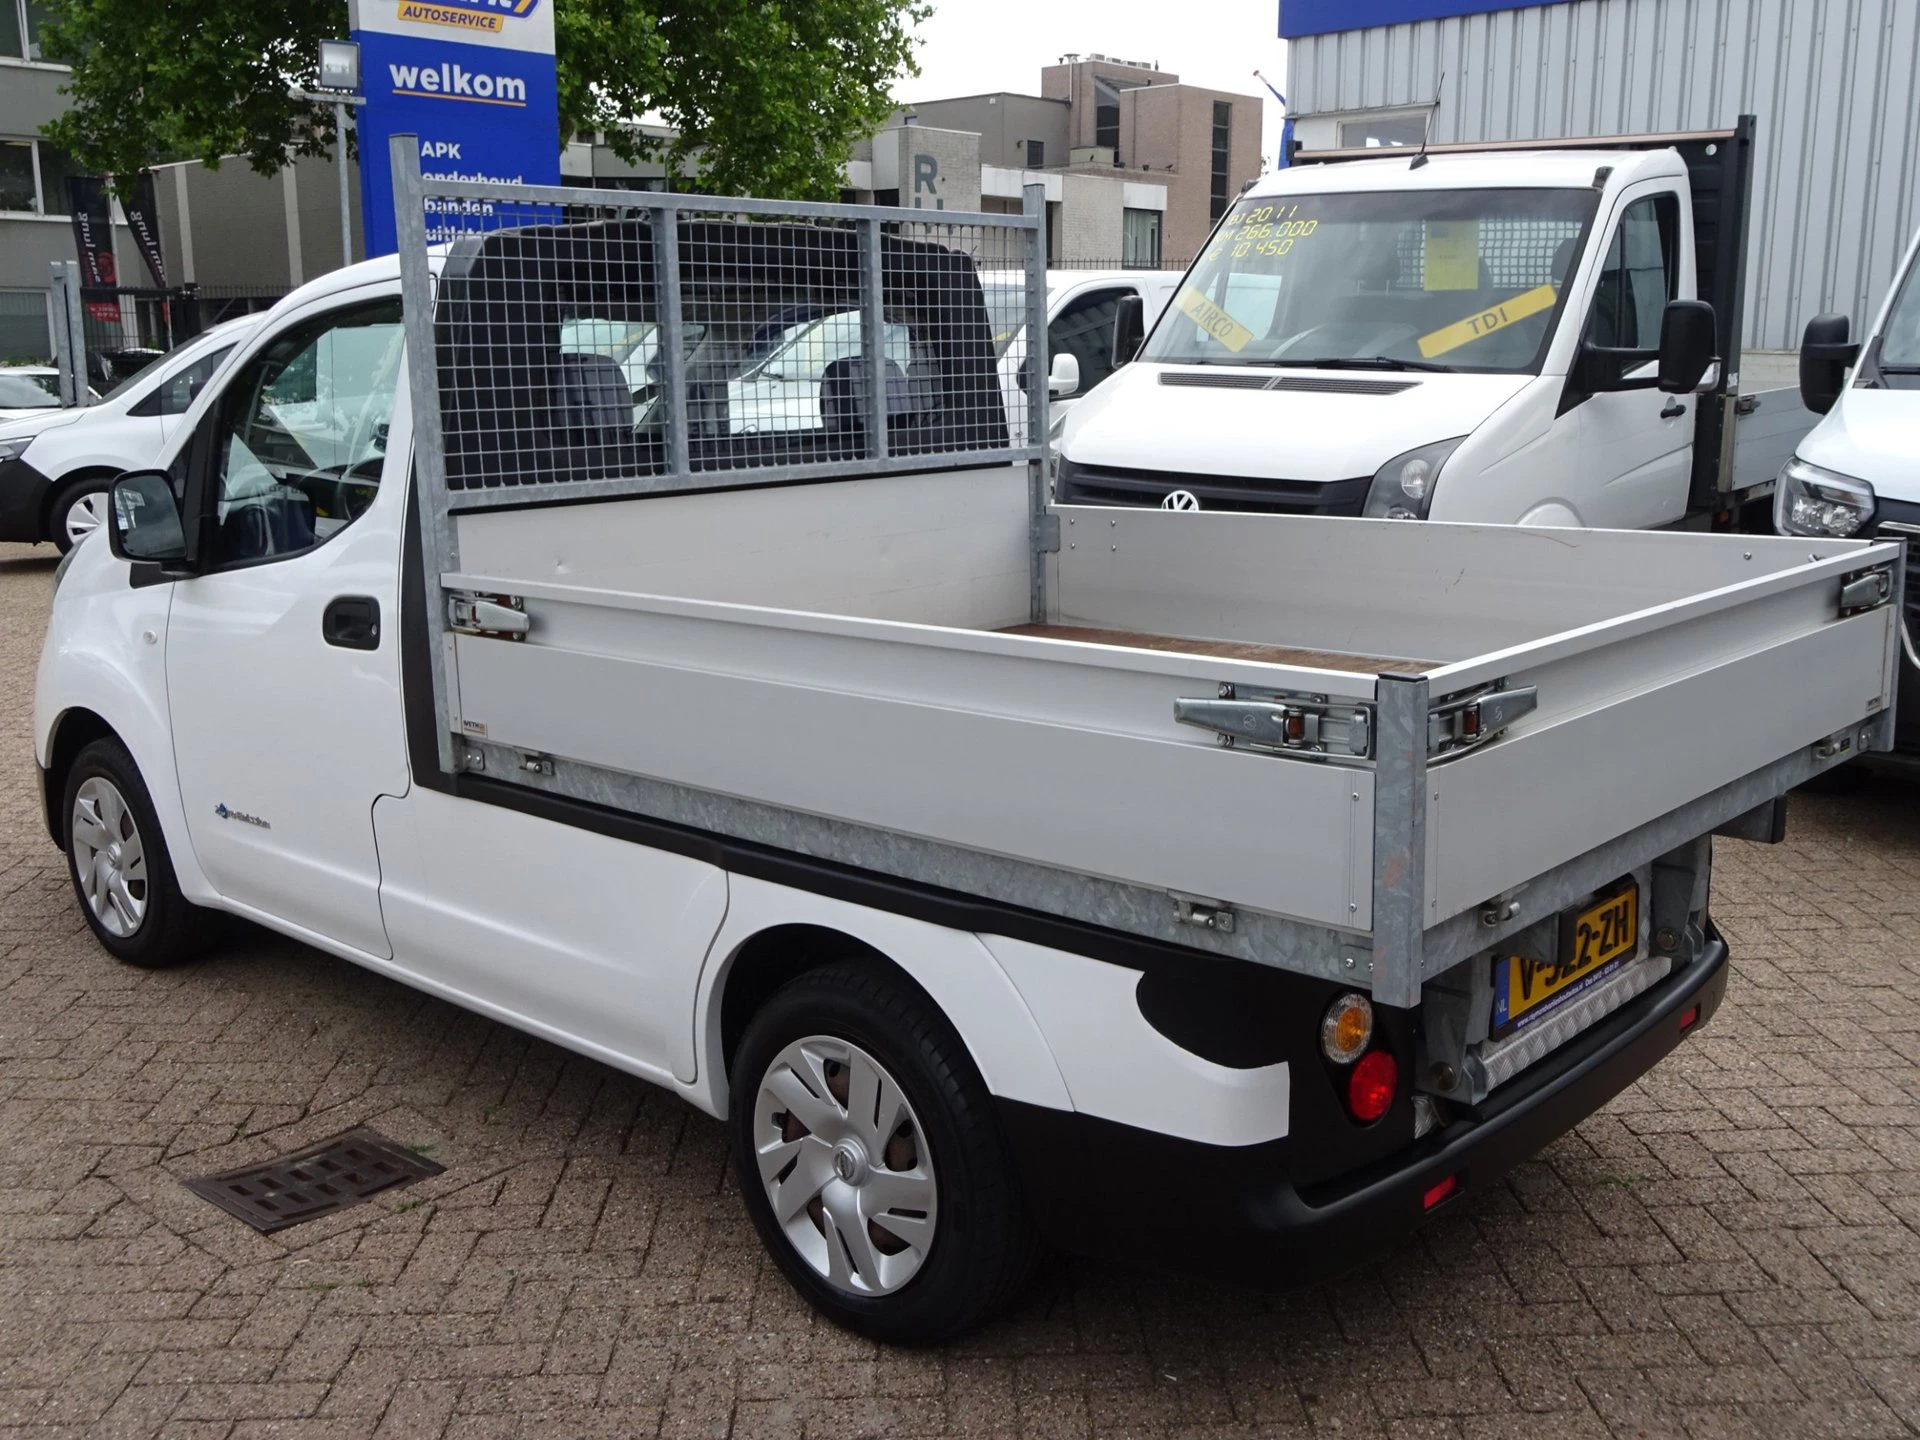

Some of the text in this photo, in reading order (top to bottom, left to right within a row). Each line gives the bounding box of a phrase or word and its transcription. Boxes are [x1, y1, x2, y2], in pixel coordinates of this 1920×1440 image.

[403, 6, 497, 28] AUTOSERVICE
[389, 63, 526, 100] welkom
[421, 141, 461, 159] APK
[424, 198, 494, 217] banden
[1246, 205, 1298, 223] 2011
[1235, 220, 1318, 241] 266.000
[1190, 301, 1234, 337] AIRCO
[1465, 307, 1508, 335] TDI
